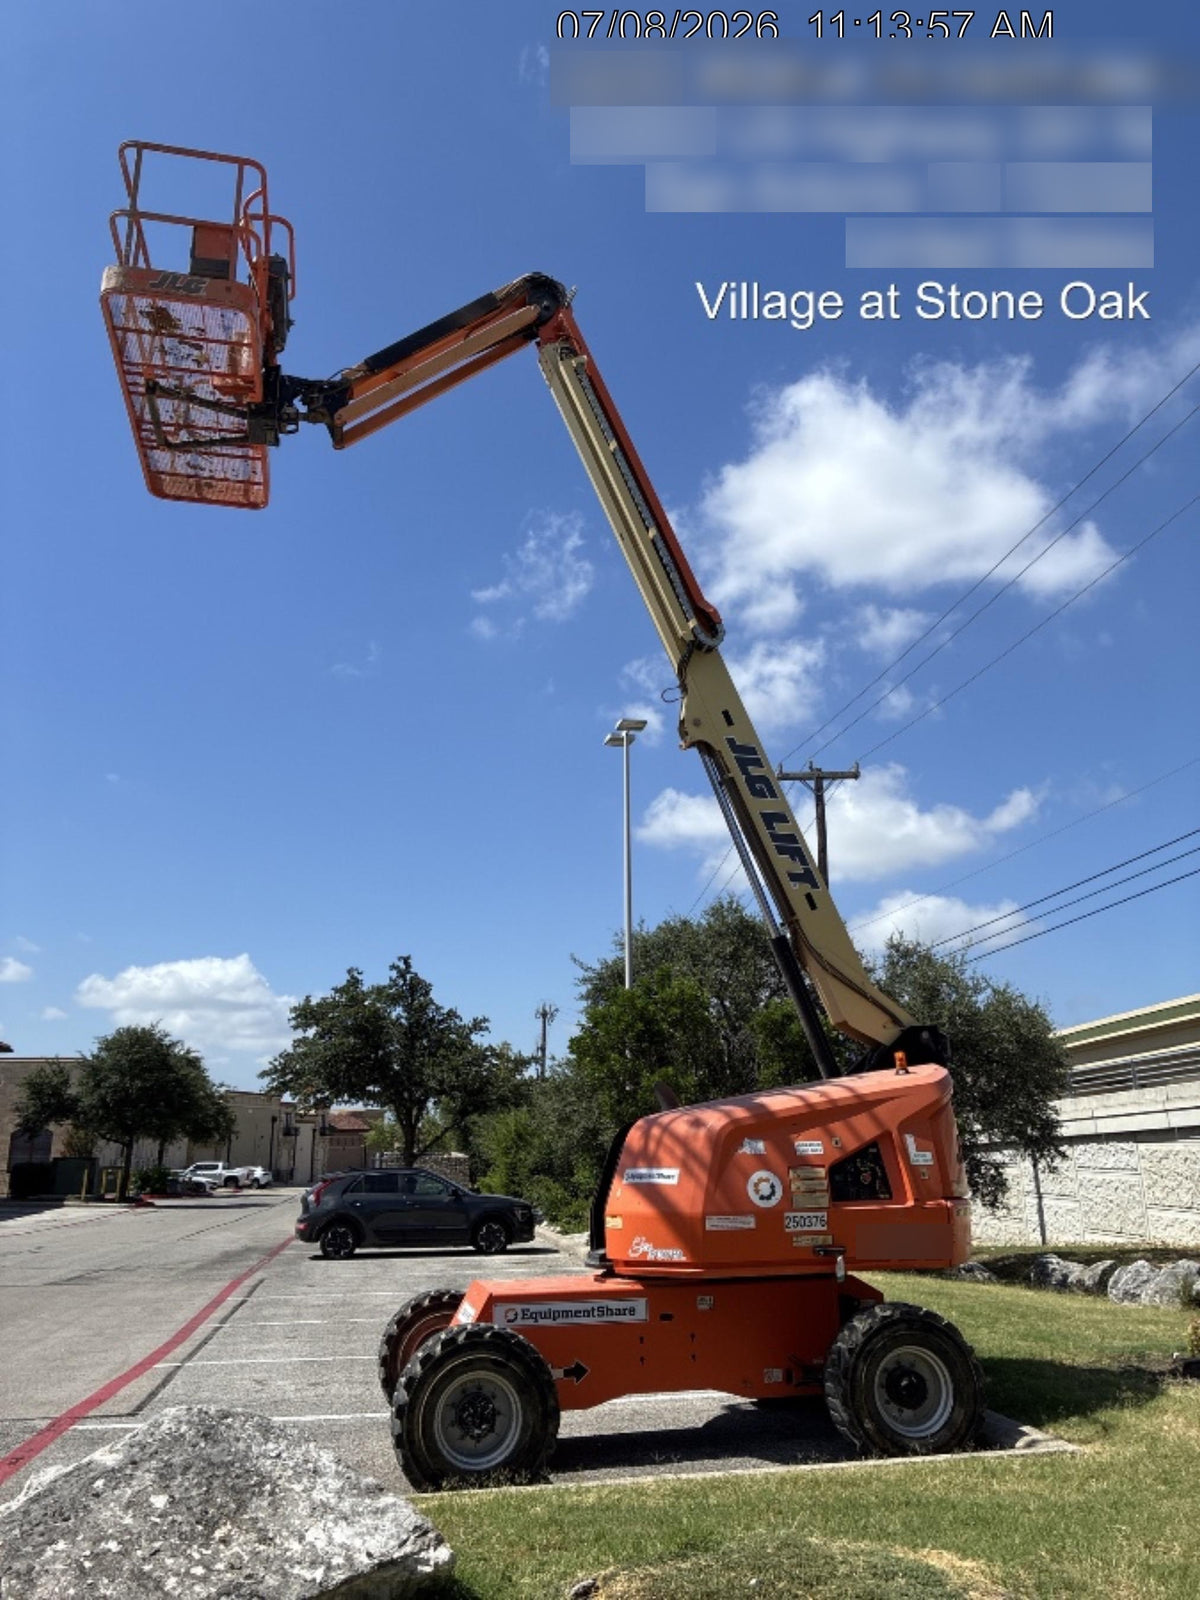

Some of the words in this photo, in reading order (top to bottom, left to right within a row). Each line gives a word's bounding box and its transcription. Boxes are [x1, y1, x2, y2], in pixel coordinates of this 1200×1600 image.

[149, 271, 209, 295] JLG
[724, 736, 779, 799] JLG
[759, 810, 821, 891] LIFT
[784, 1215, 827, 1230] 250376
[520, 1304, 636, 1322] EquipmentShare
